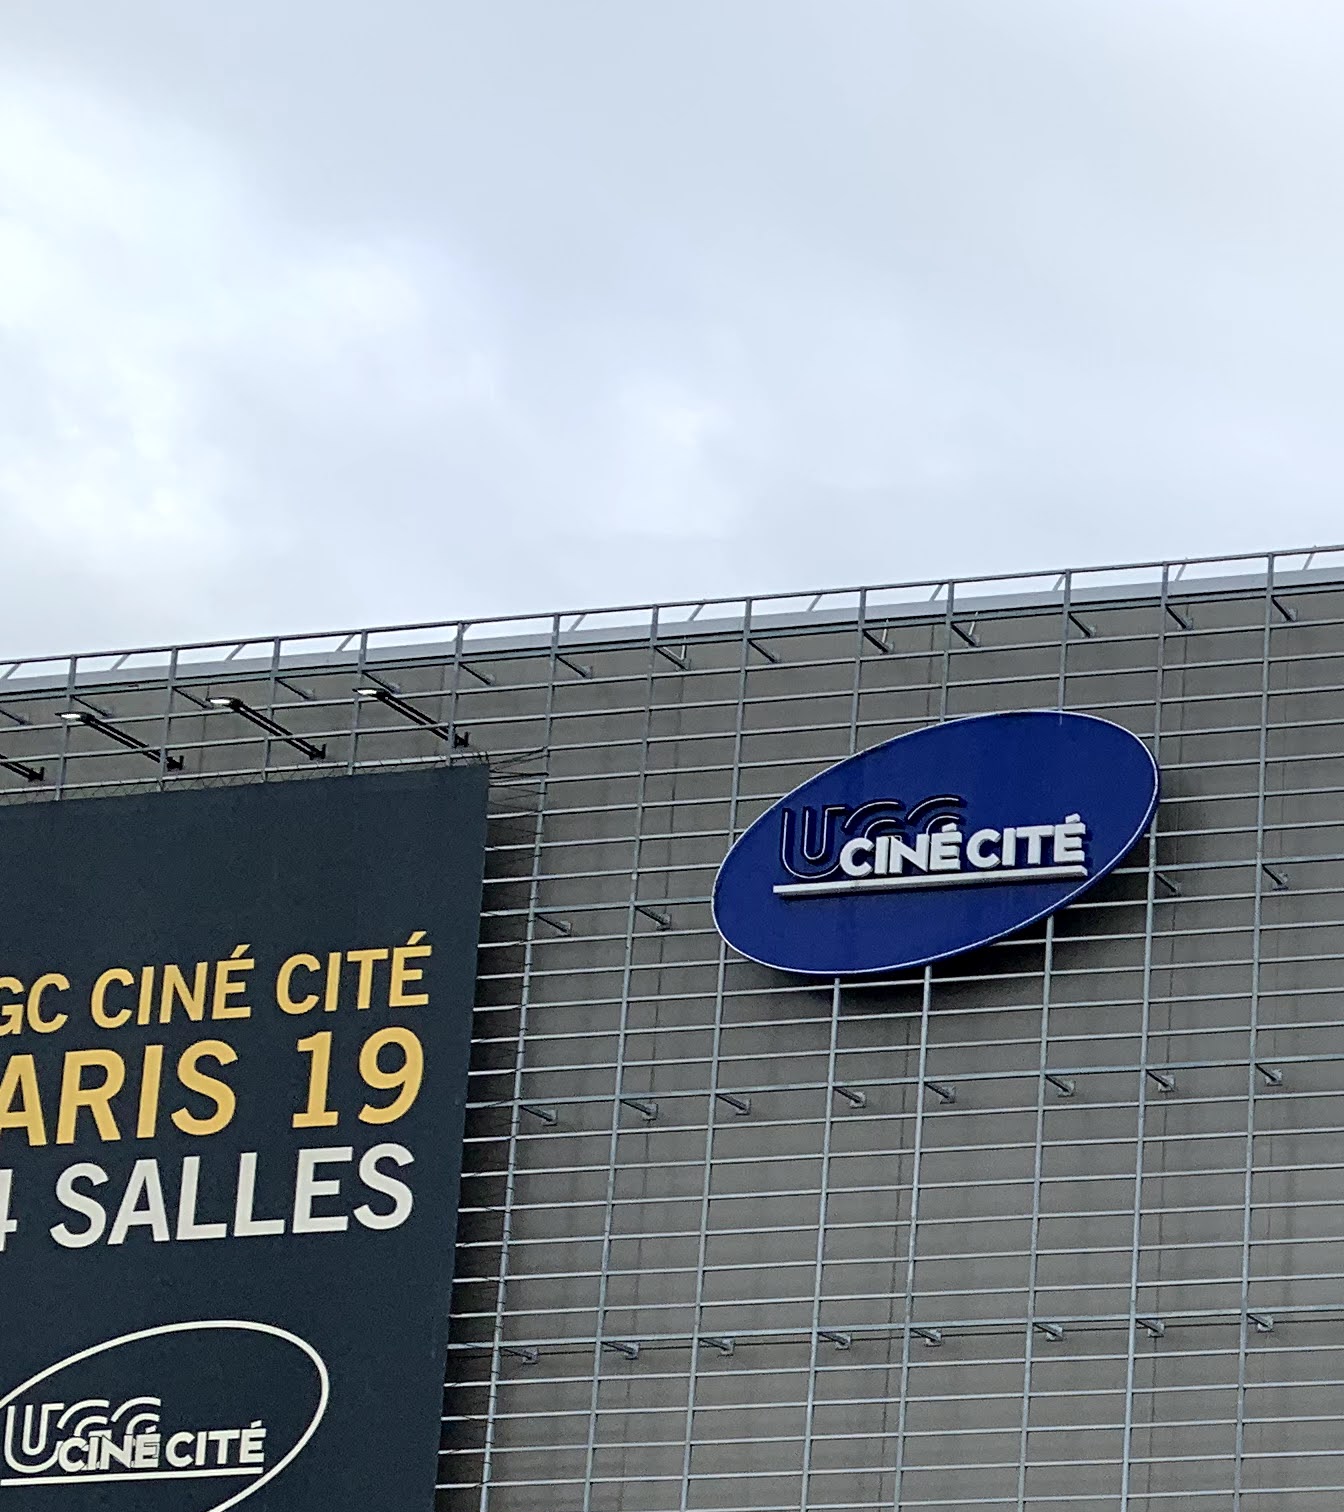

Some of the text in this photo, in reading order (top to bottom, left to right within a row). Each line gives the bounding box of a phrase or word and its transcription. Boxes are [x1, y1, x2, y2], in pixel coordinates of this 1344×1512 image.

[839, 813, 1087, 878] CINÉ CITÉ
[90, 944, 255, 1029] CINÉ
[276, 931, 433, 1015] CITÉ
[292, 1026, 425, 1128] 19
[49, 1142, 415, 1248] SALLES
[58, 1420, 266, 1472] CINÉ CITÉ
